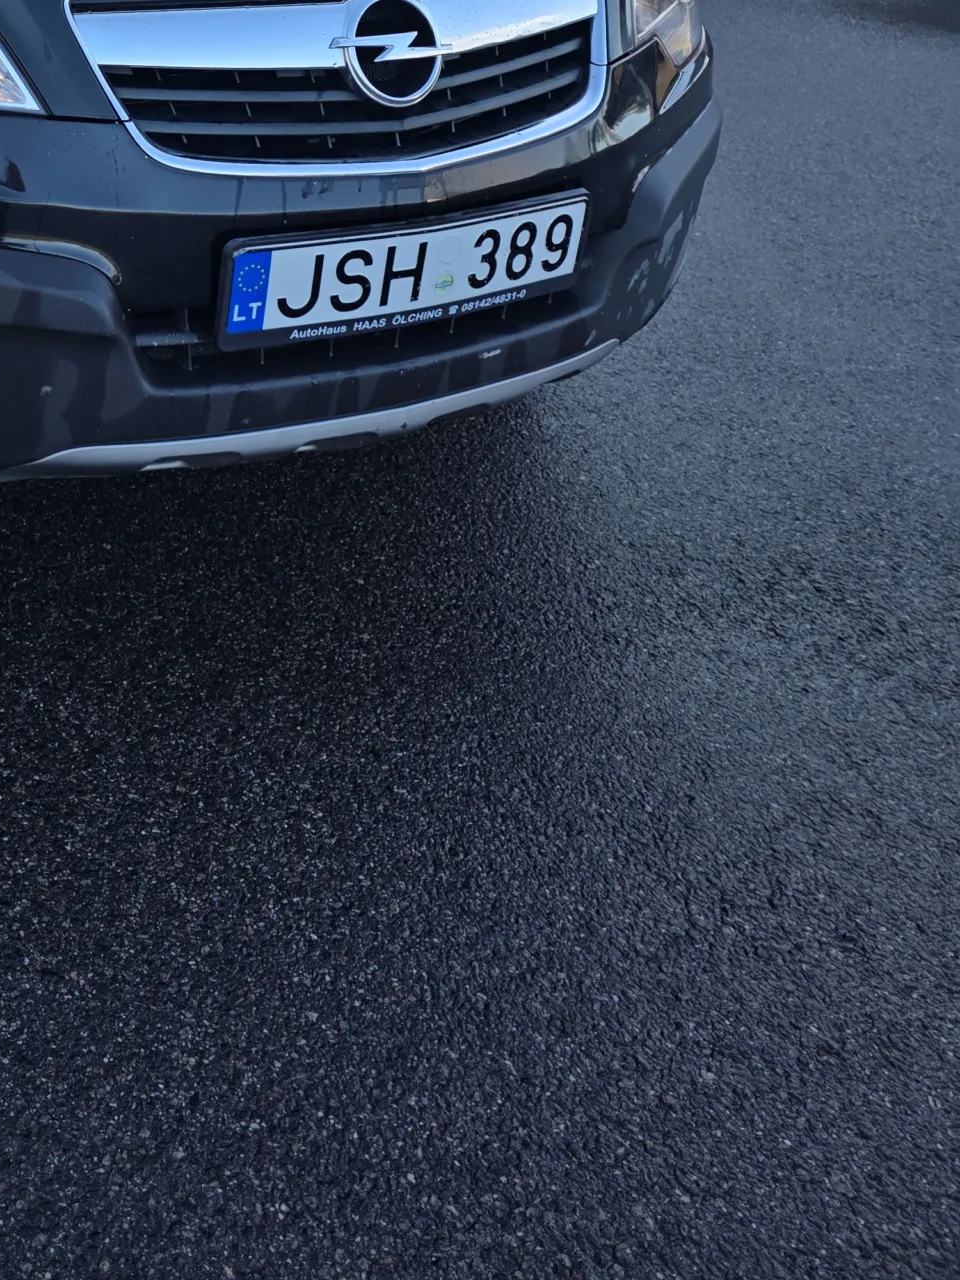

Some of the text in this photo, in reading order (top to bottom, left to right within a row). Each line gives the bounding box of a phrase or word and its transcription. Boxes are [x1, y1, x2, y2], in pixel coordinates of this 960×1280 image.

[277, 214, 574, 318] JSH 389
[233, 302, 262, 322] LT
[289, 324, 347, 340] AutoHaus
[352, 318, 386, 332] HAAS
[392, 308, 443, 326] ÖLCHING
